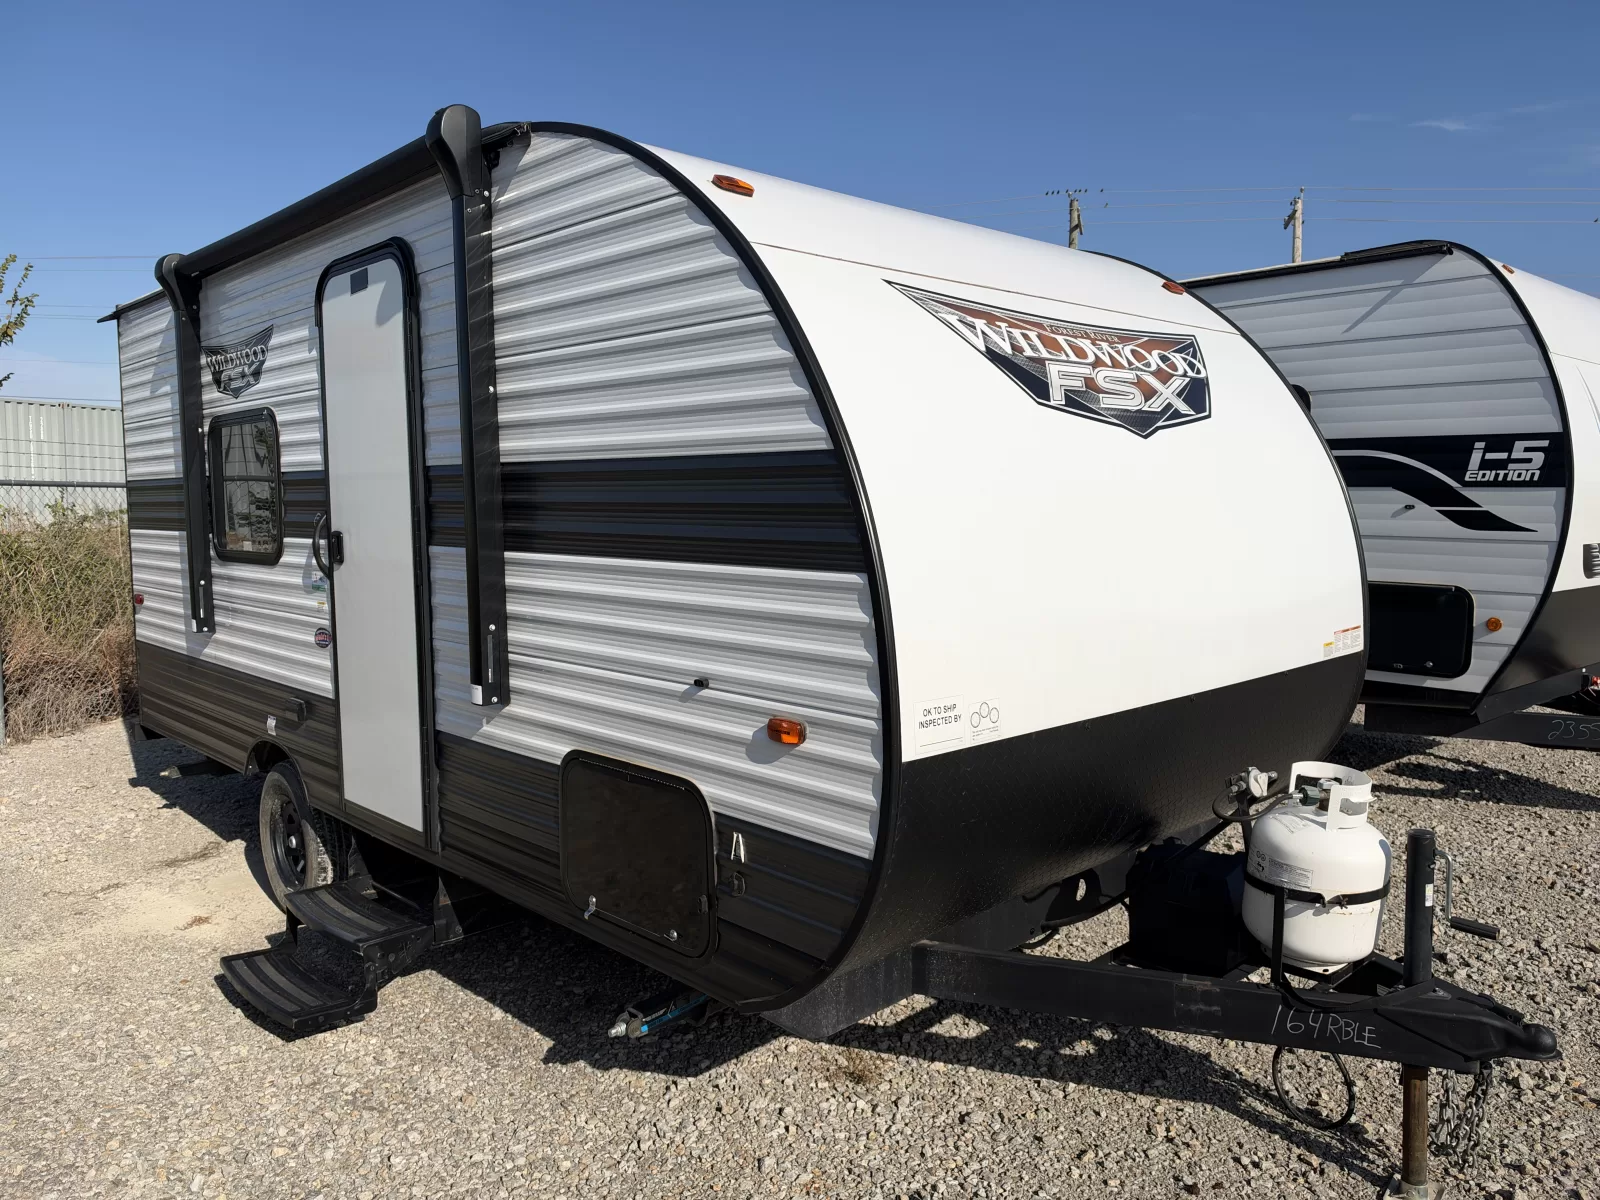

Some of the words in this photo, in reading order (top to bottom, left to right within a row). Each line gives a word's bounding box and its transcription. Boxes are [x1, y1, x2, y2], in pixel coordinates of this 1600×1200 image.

[937, 312, 1207, 379] WILDWOOD
[1043, 323, 1087, 338] FOREST
[1086, 329, 1121, 343] RIVER
[207, 345, 268, 373] WILDWOOD
[1045, 360, 1196, 415] FSX
[1467, 439, 1550, 471] i-5
[1464, 469, 1541, 482] EDITION
[918, 715, 953, 729] INSPECTED
[953, 713, 962, 723] BY
[922, 707, 932, 717] OK
[933, 706, 942, 715] TO
[943, 703, 957, 714] SHIP
[1271, 1004, 1382, 1049] 164RBLE
